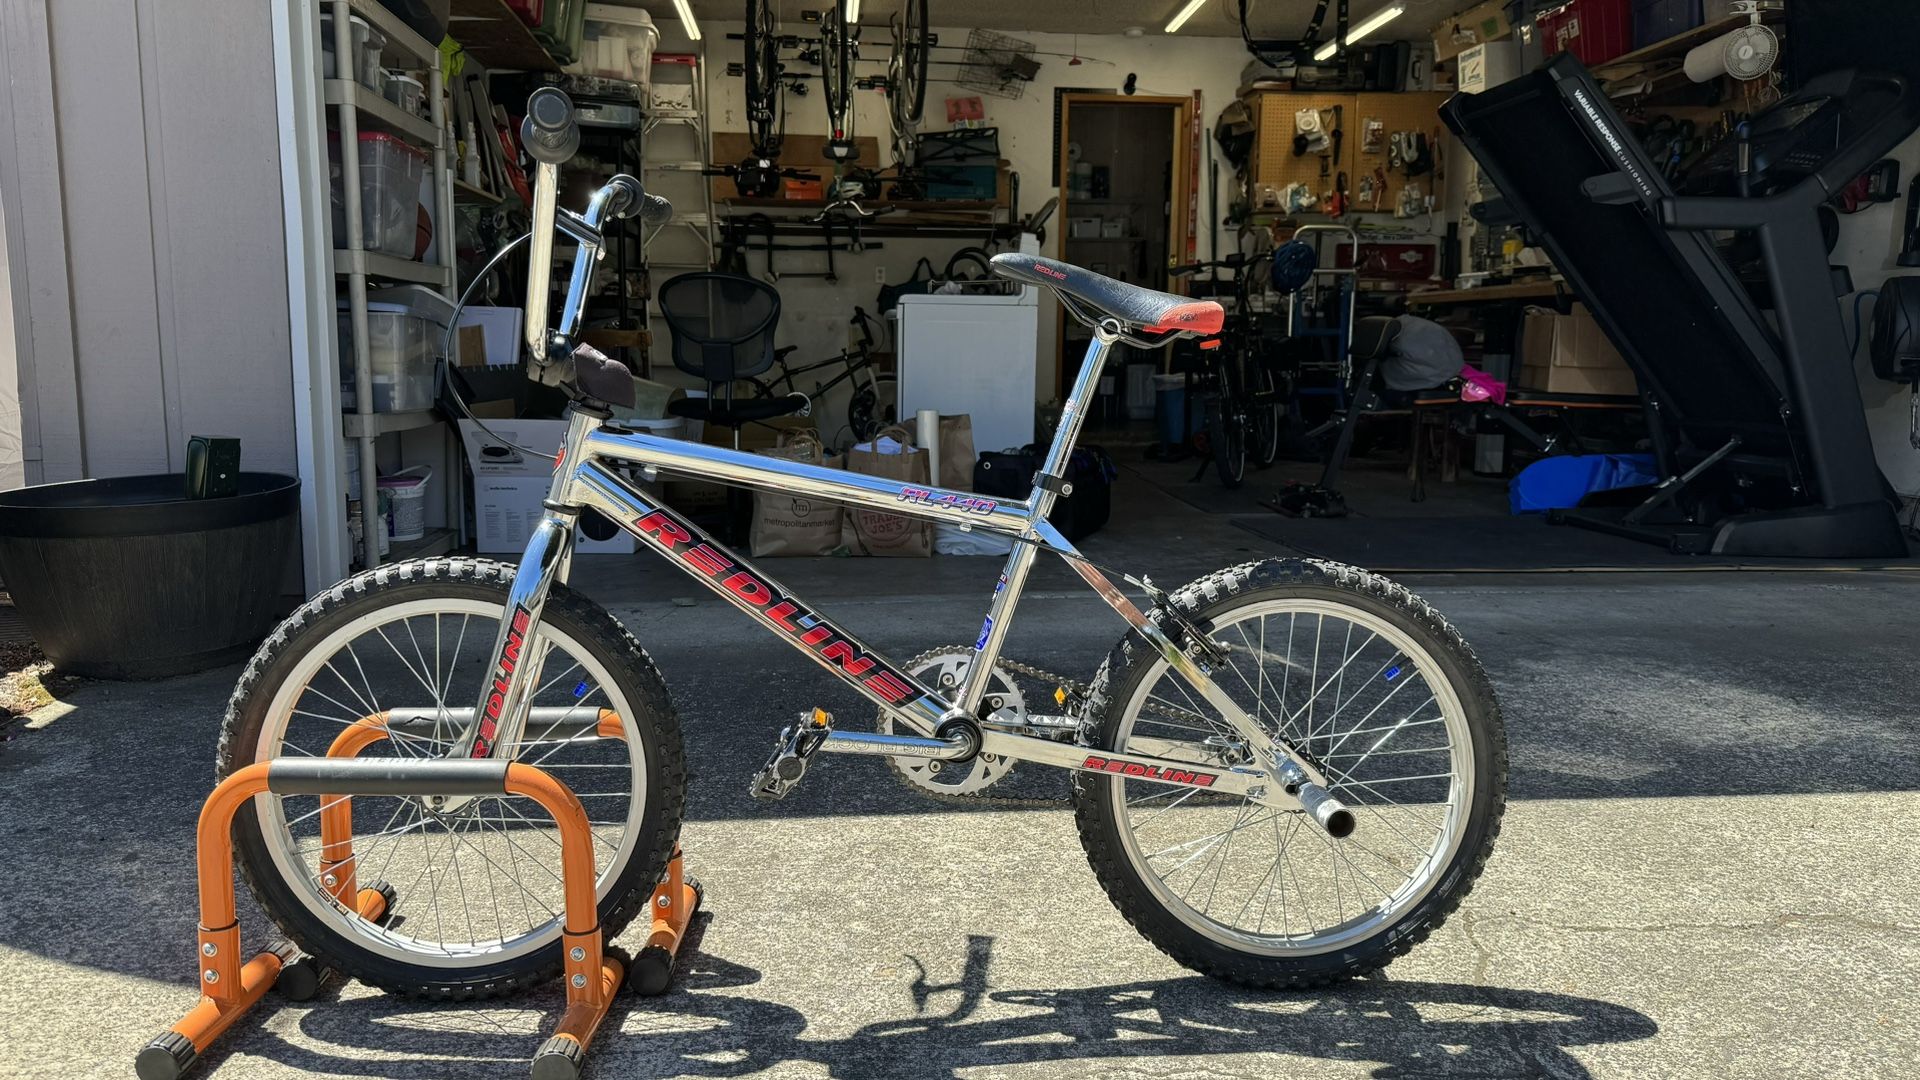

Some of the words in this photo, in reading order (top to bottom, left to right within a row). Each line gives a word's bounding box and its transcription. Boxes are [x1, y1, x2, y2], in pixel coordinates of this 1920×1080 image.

[1574, 89, 1599, 121] VARIABLE
[1594, 118, 1622, 153] RESPONSE
[1616, 150, 1651, 196] CUSHIONING
[1033, 263, 1067, 281] REDLINE
[897, 486, 998, 517] RL440
[764, 517, 835, 529] metropolitanmarket
[870, 520, 903, 534] JOE'S
[635, 512, 914, 702] REDLINE
[1083, 757, 1216, 787] REDLINE
